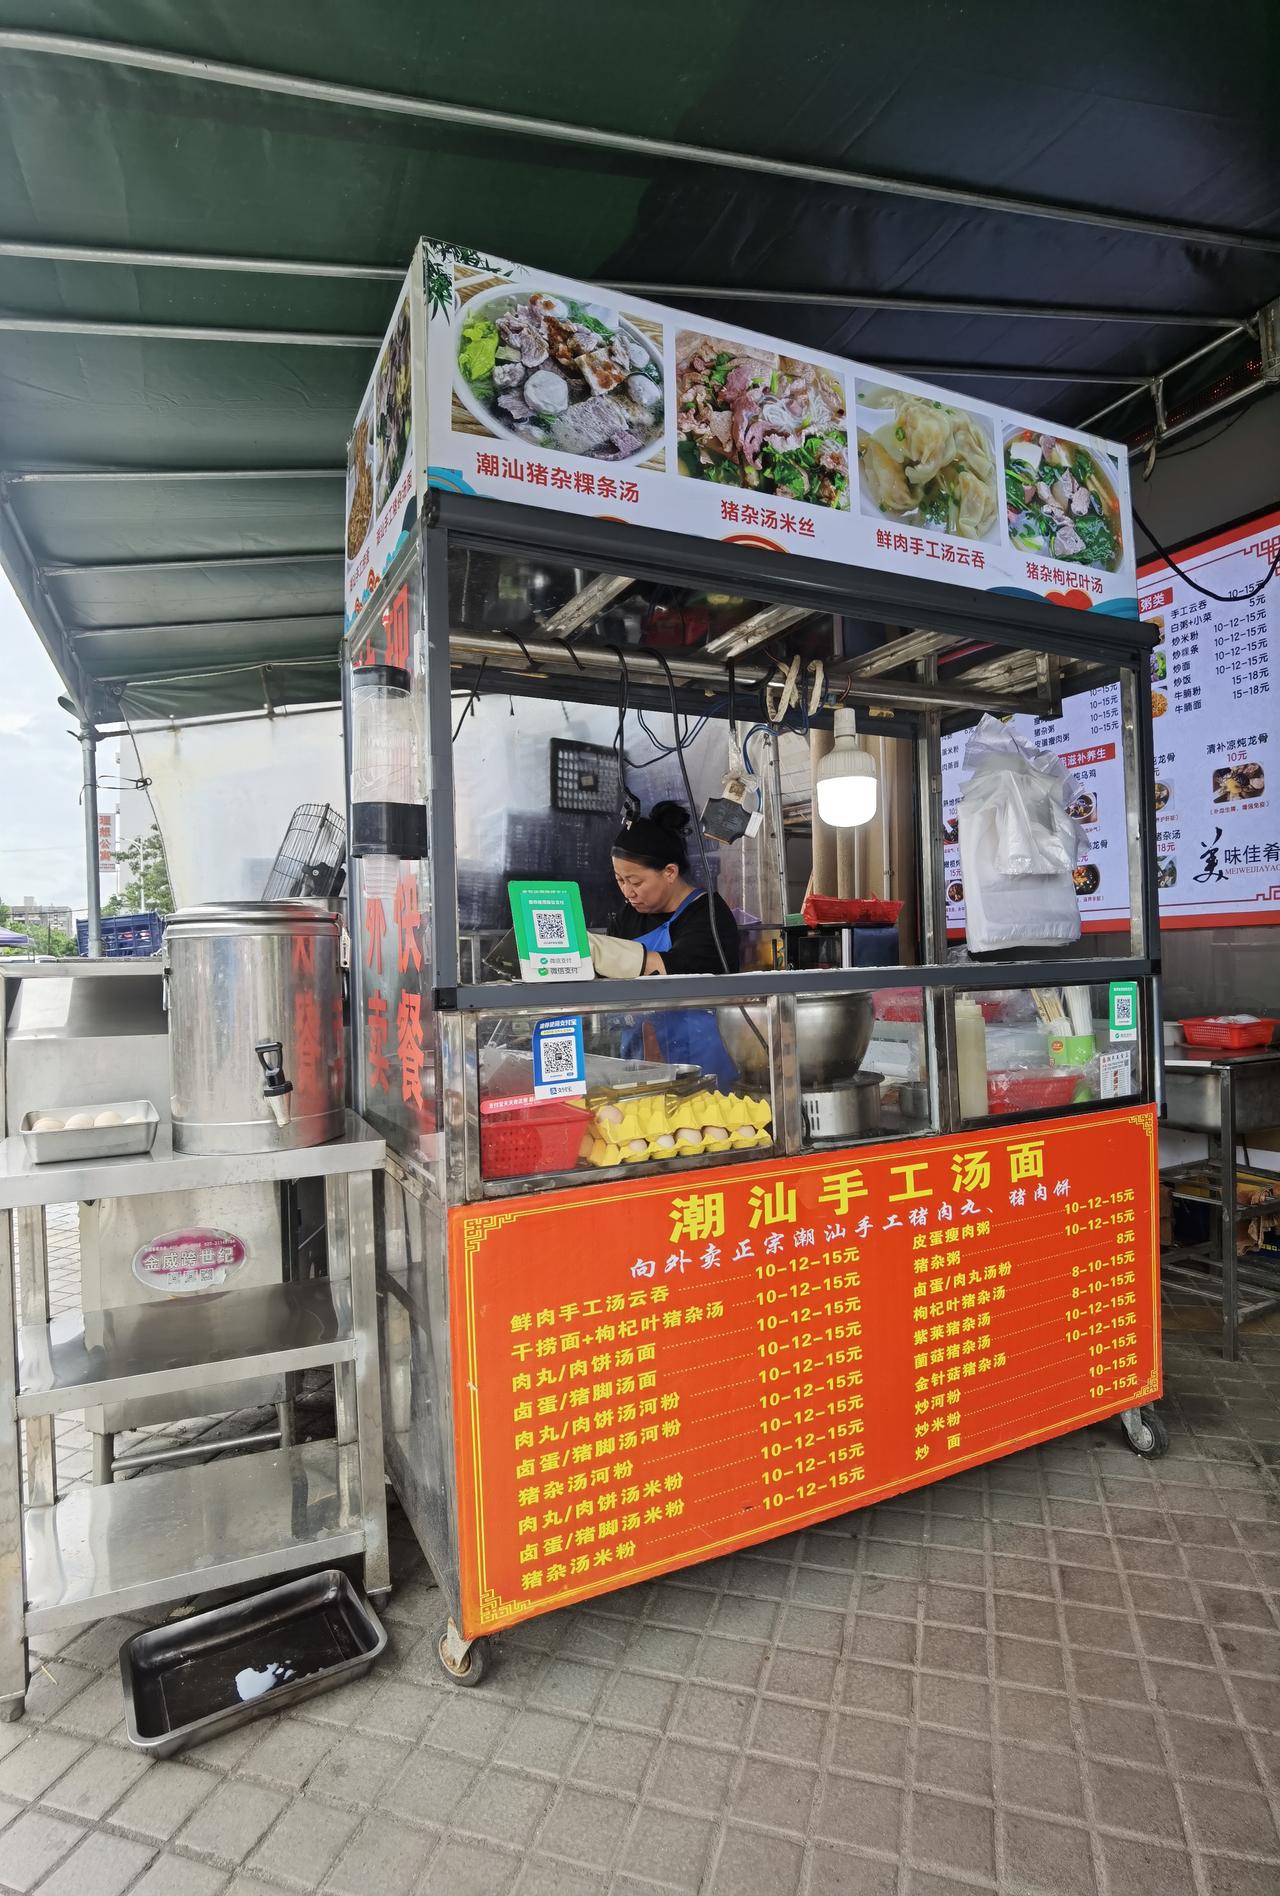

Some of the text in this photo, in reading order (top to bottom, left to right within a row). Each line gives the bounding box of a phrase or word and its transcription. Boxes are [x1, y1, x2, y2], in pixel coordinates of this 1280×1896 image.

[476, 452, 640, 506] 潮汕猪杂粿条汤
[721, 499, 816, 538] 猪杂汤米丝
[876, 528, 986, 571] 鲜肉手工汤云吞
[1026, 561, 1104, 595] 猪杂枸杞叶汤
[1140, 593, 1165, 613] 粥类
[1171, 600, 1207, 620] 手工云吞
[1249, 596, 1266, 607] 5元
[1171, 612, 1212, 634] 白粥+小菜
[1214, 609, 1267, 633] 10-12-15元
[1214, 623, 1267, 647] 10-12-15元
[1172, 630, 1199, 647] 炒米粉
[1215, 638, 1268, 661] 10-12-15元
[1173, 660, 1191, 674] 炒面
[1174, 674, 1192, 688] 炒饭
[1216, 653, 1269, 675] 10-12-15元
[1232, 667, 1269, 685] 15-18元
[1089, 695, 1118, 709] 10-15元
[1174, 686, 1201, 701] 牛腩粉
[1175, 699, 1202, 715] 牛腩面
[1233, 682, 1270, 700] 15-18元
[1089, 708, 1119, 722] 10-15元
[1091, 720, 1119, 735] 10-15元
[1207, 733, 1268, 755] 清补凉炖龙骨
[1227, 750, 1247, 762] 10元
[669, 1141, 1045, 1243] 潮汕手工汤面
[913, 1189, 1134, 1249] 皮蛋瘦肉粥 10-12-15元
[914, 1210, 1134, 1273] 猪杂粥 10-12-15元
[914, 1230, 1134, 1298] 卤蛋/肉丸汤粉 8元
[510, 1247, 859, 1332] 鲜肉手工汤云吞 10-12-15元
[913, 1251, 1134, 1321] 枸杞叶猪杂汤 8-10-15元
[1073, 1271, 1135, 1298] 8-10-15元
[511, 1272, 860, 1361] 干捞面+枸杞叶猪杂汤 10-12-15元
[914, 1292, 1135, 1369] 菌菇猪杂汤 10-12-15元
[512, 1297, 861, 1392] 肉丸/肉饼汤面 10-12-15元
[915, 1312, 1136, 1392] 金针菇猪杂汤 10-12-15元
[514, 1322, 861, 1422] 卤蛋/猪脚汤面 10-12-15元
[915, 1333, 1136, 1415] 炒河粉 10-15元
[1090, 1374, 1137, 1397] 10-15元
[515, 1346, 862, 1450] 肉丸/肉饼汤河粉 10-12-15元
[915, 1353, 1137, 1438] 炒米粉 10-15元
[516, 1371, 863, 1479] 卤蛋/猪脚汤河粉 10-12-15元
[518, 1395, 863, 1506] 猪杂汤河粉 10-12-15元
[519, 1419, 864, 1535] 肉丸/肉饼汤米粉 10-12-15元
[520, 1443, 864, 1564] 卤蛋/猪脚汤米粉 10-12-15元
[522, 1467, 864, 1590] 猪杂汤米粉 10-12-15元
